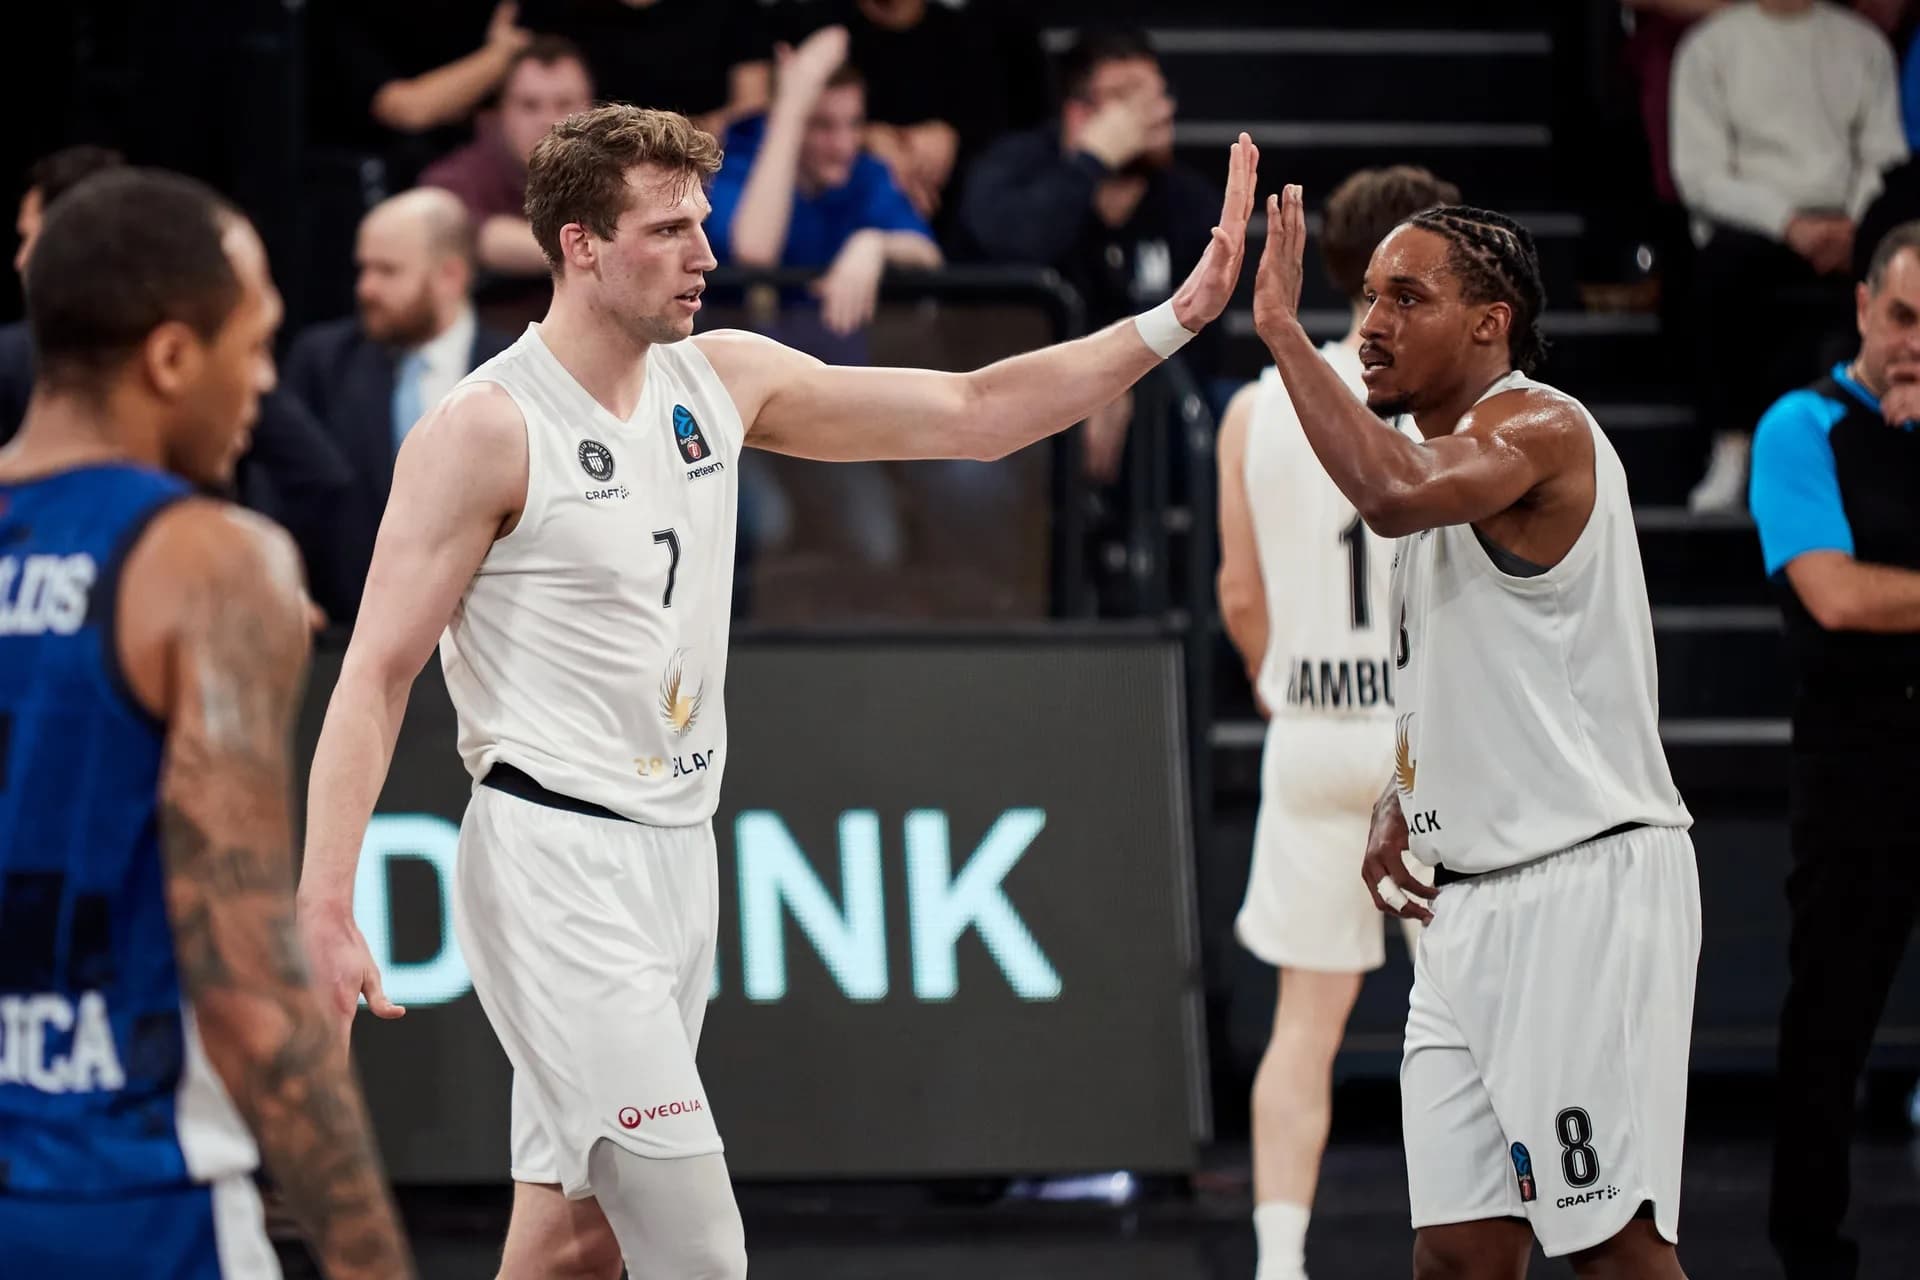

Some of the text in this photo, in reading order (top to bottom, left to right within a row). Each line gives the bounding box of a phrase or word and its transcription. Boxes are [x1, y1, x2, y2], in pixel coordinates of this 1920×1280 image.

[687, 462, 724, 479] oneteam
[585, 488, 619, 500] CRAFT
[651, 527, 681, 609] 7
[353, 810, 1063, 1005] DNK
[644, 1099, 703, 1120] VEOLIA
[1555, 1106, 1600, 1189] 8
[1556, 1189, 1605, 1209] CRAFT
